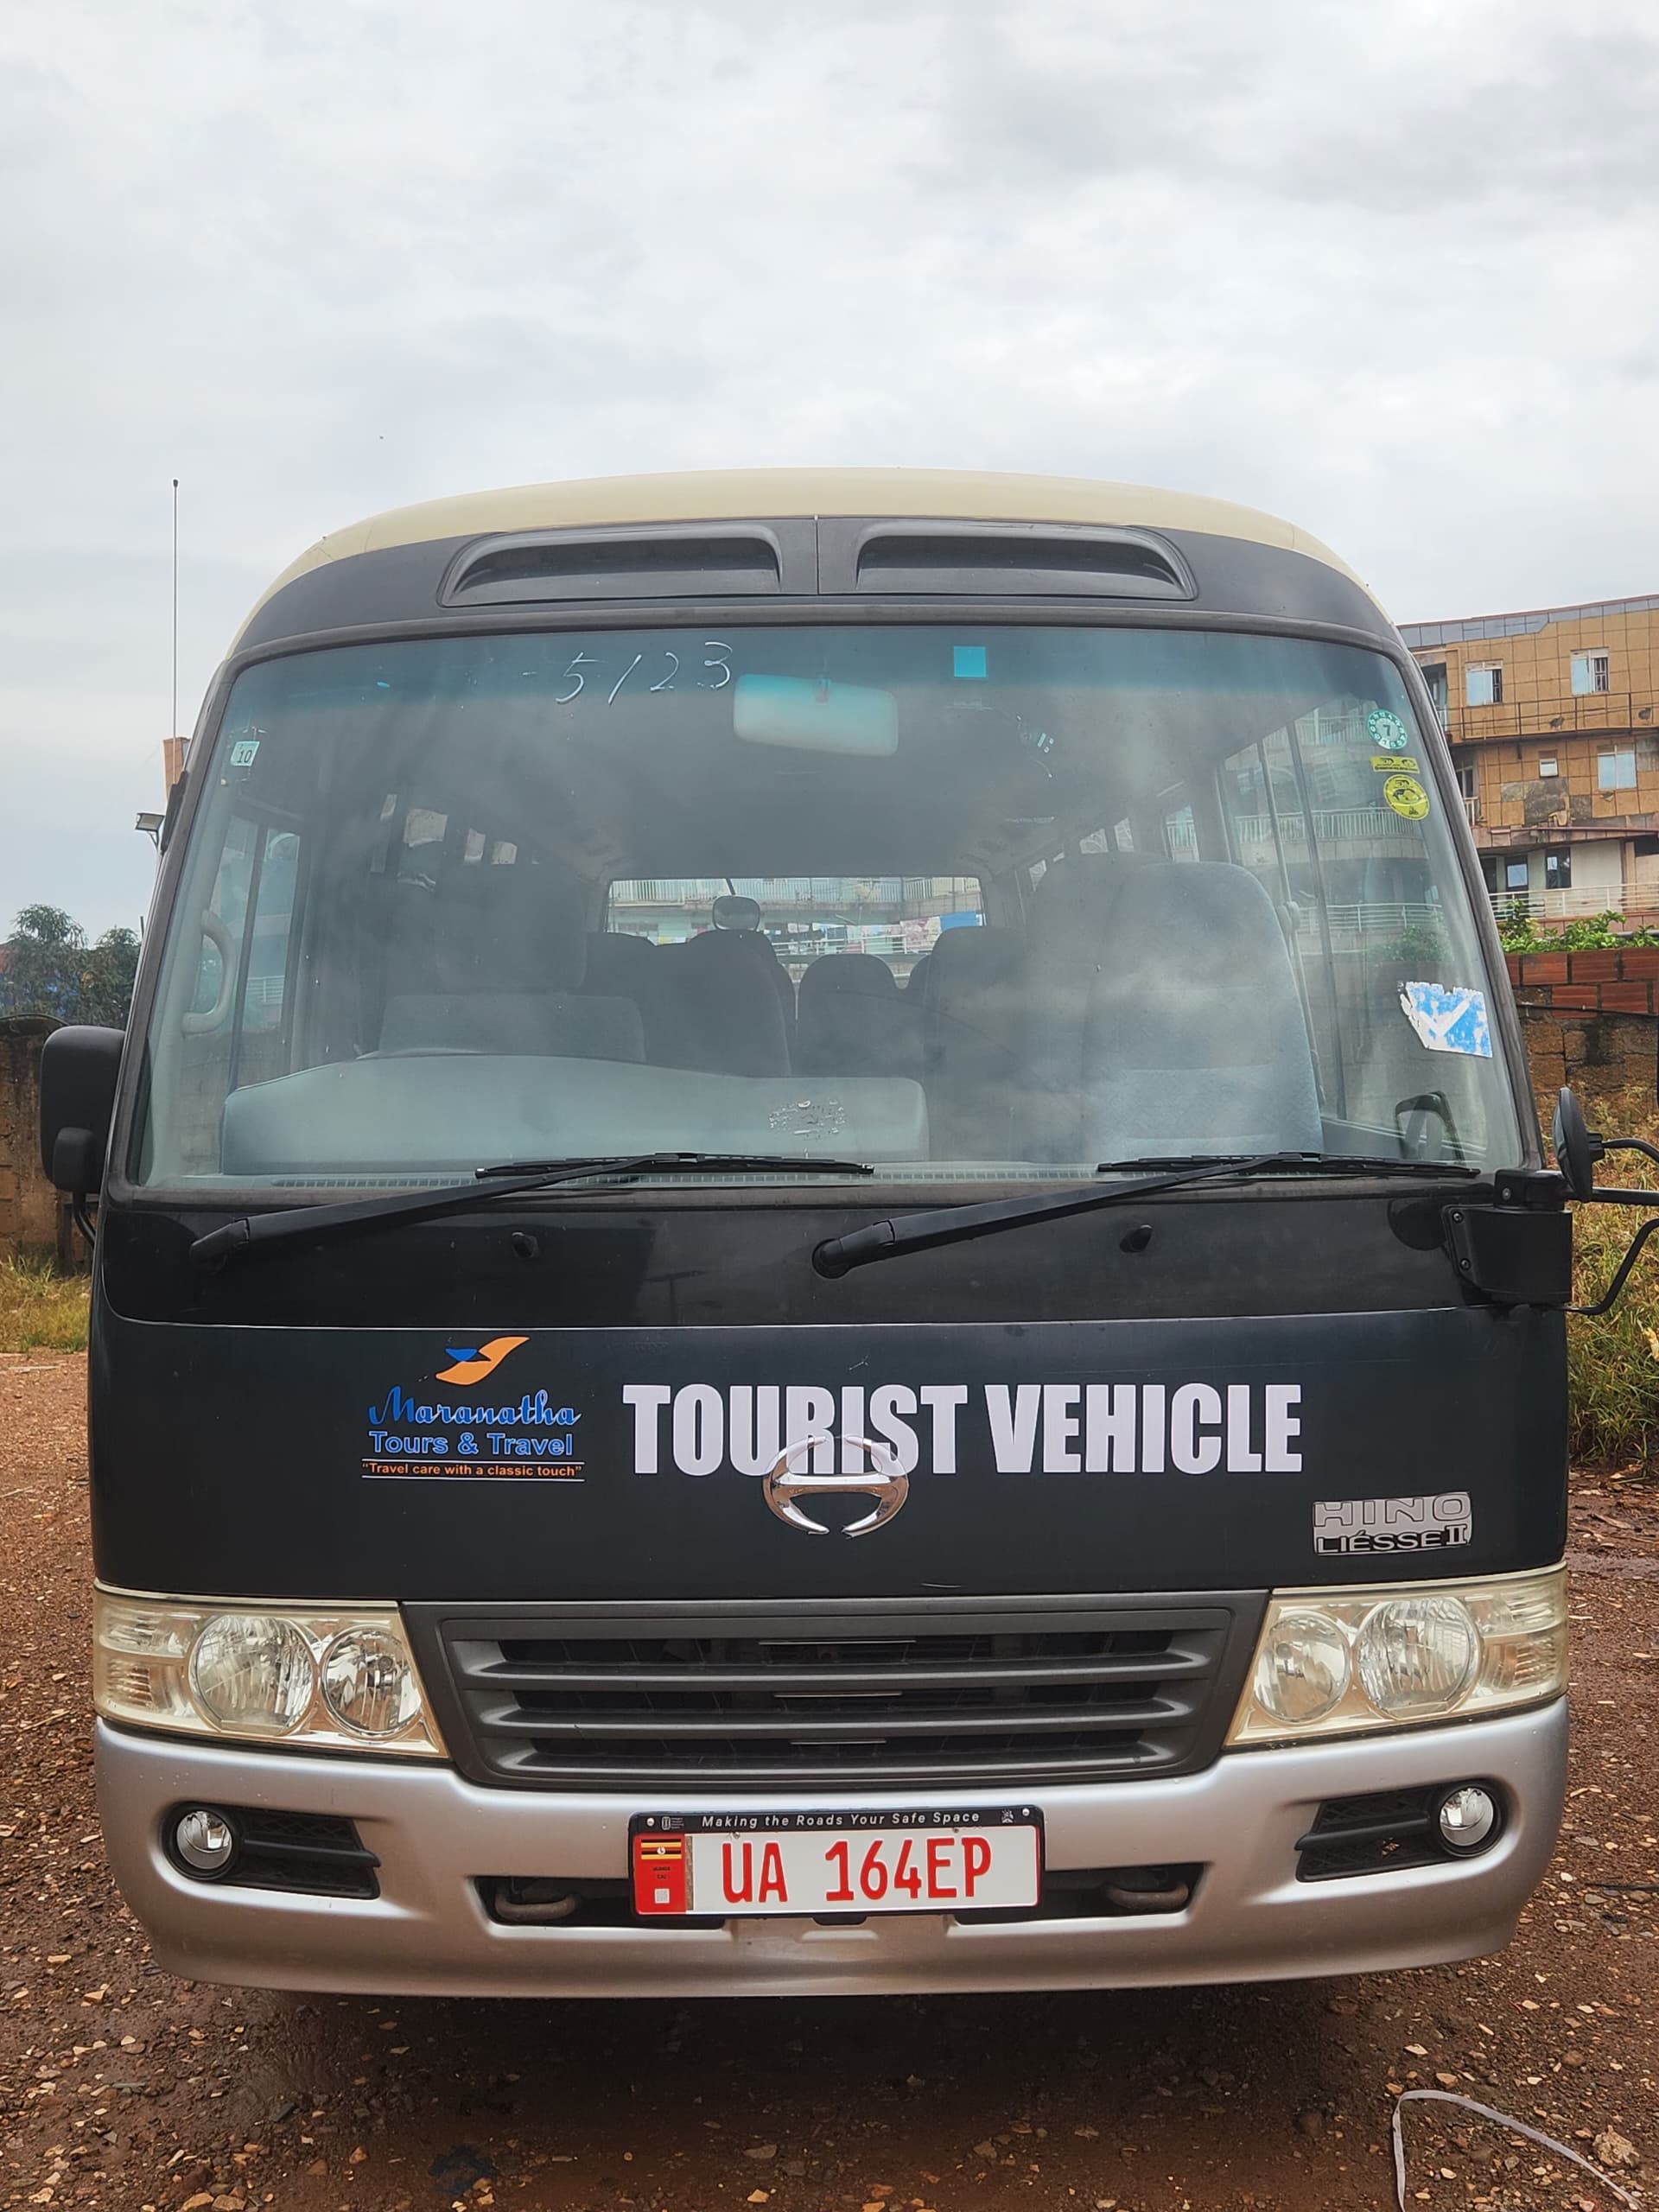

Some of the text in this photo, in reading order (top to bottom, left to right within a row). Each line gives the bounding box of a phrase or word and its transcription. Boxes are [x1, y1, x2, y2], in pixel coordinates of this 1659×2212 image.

[237, 749, 252, 763] 10
[367, 1385, 582, 1426] Maranatha
[368, 1430, 573, 1455] Tours & Travel
[621, 1382, 1303, 1477] TOURIST VEHICLE
[412, 1465, 441, 1475] care
[444, 1465, 473, 1475] with
[486, 1465, 533, 1476] classic
[1313, 1494, 1471, 1528] HINO
[702, 1811, 980, 1829] Making the Roads Your Safe Space
[721, 1835, 993, 1904] UA 164EP
